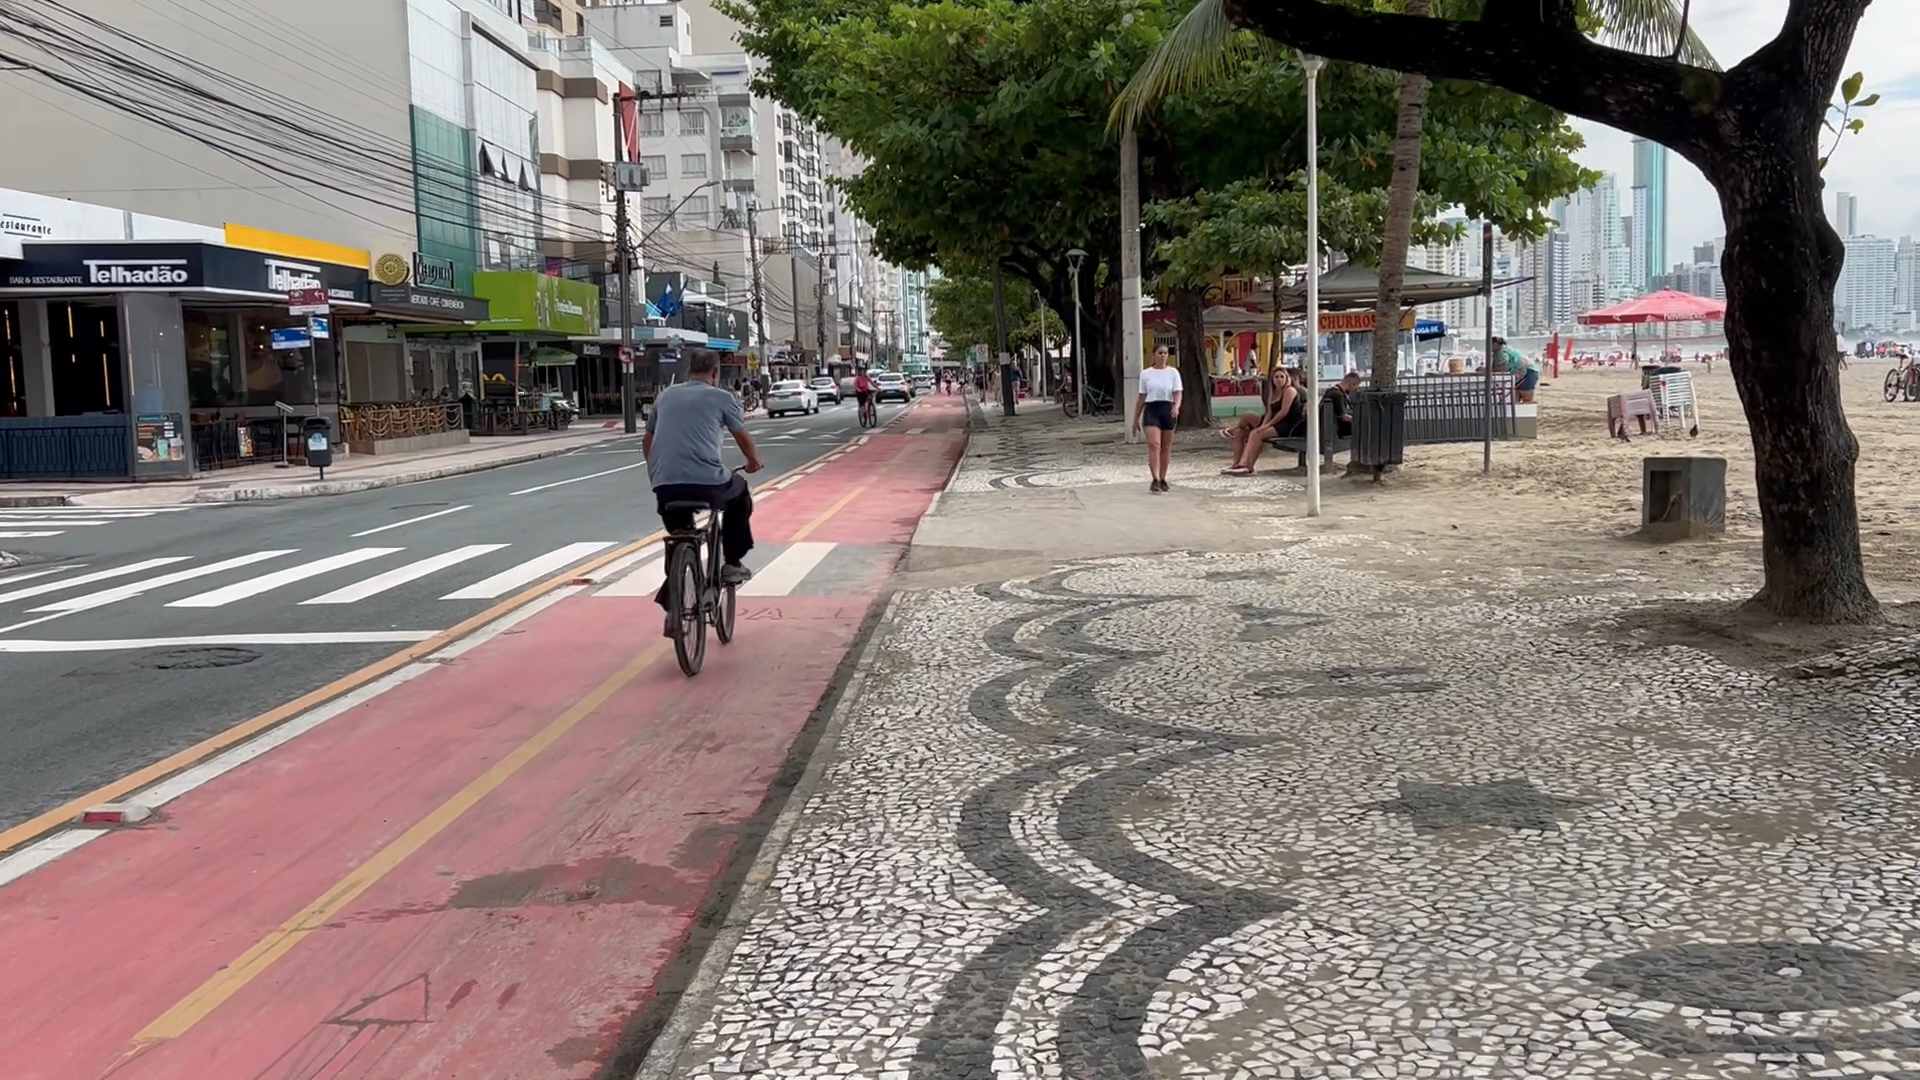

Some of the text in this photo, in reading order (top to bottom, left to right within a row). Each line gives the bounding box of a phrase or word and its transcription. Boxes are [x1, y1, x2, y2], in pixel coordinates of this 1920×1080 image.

[0, 220, 52, 235] estaurante
[9, 276, 24, 284] BAR
[32, 276, 83, 285] RESTAURANTE
[82, 259, 188, 284] Telhadão
[264, 258, 321, 290] Telhadão
